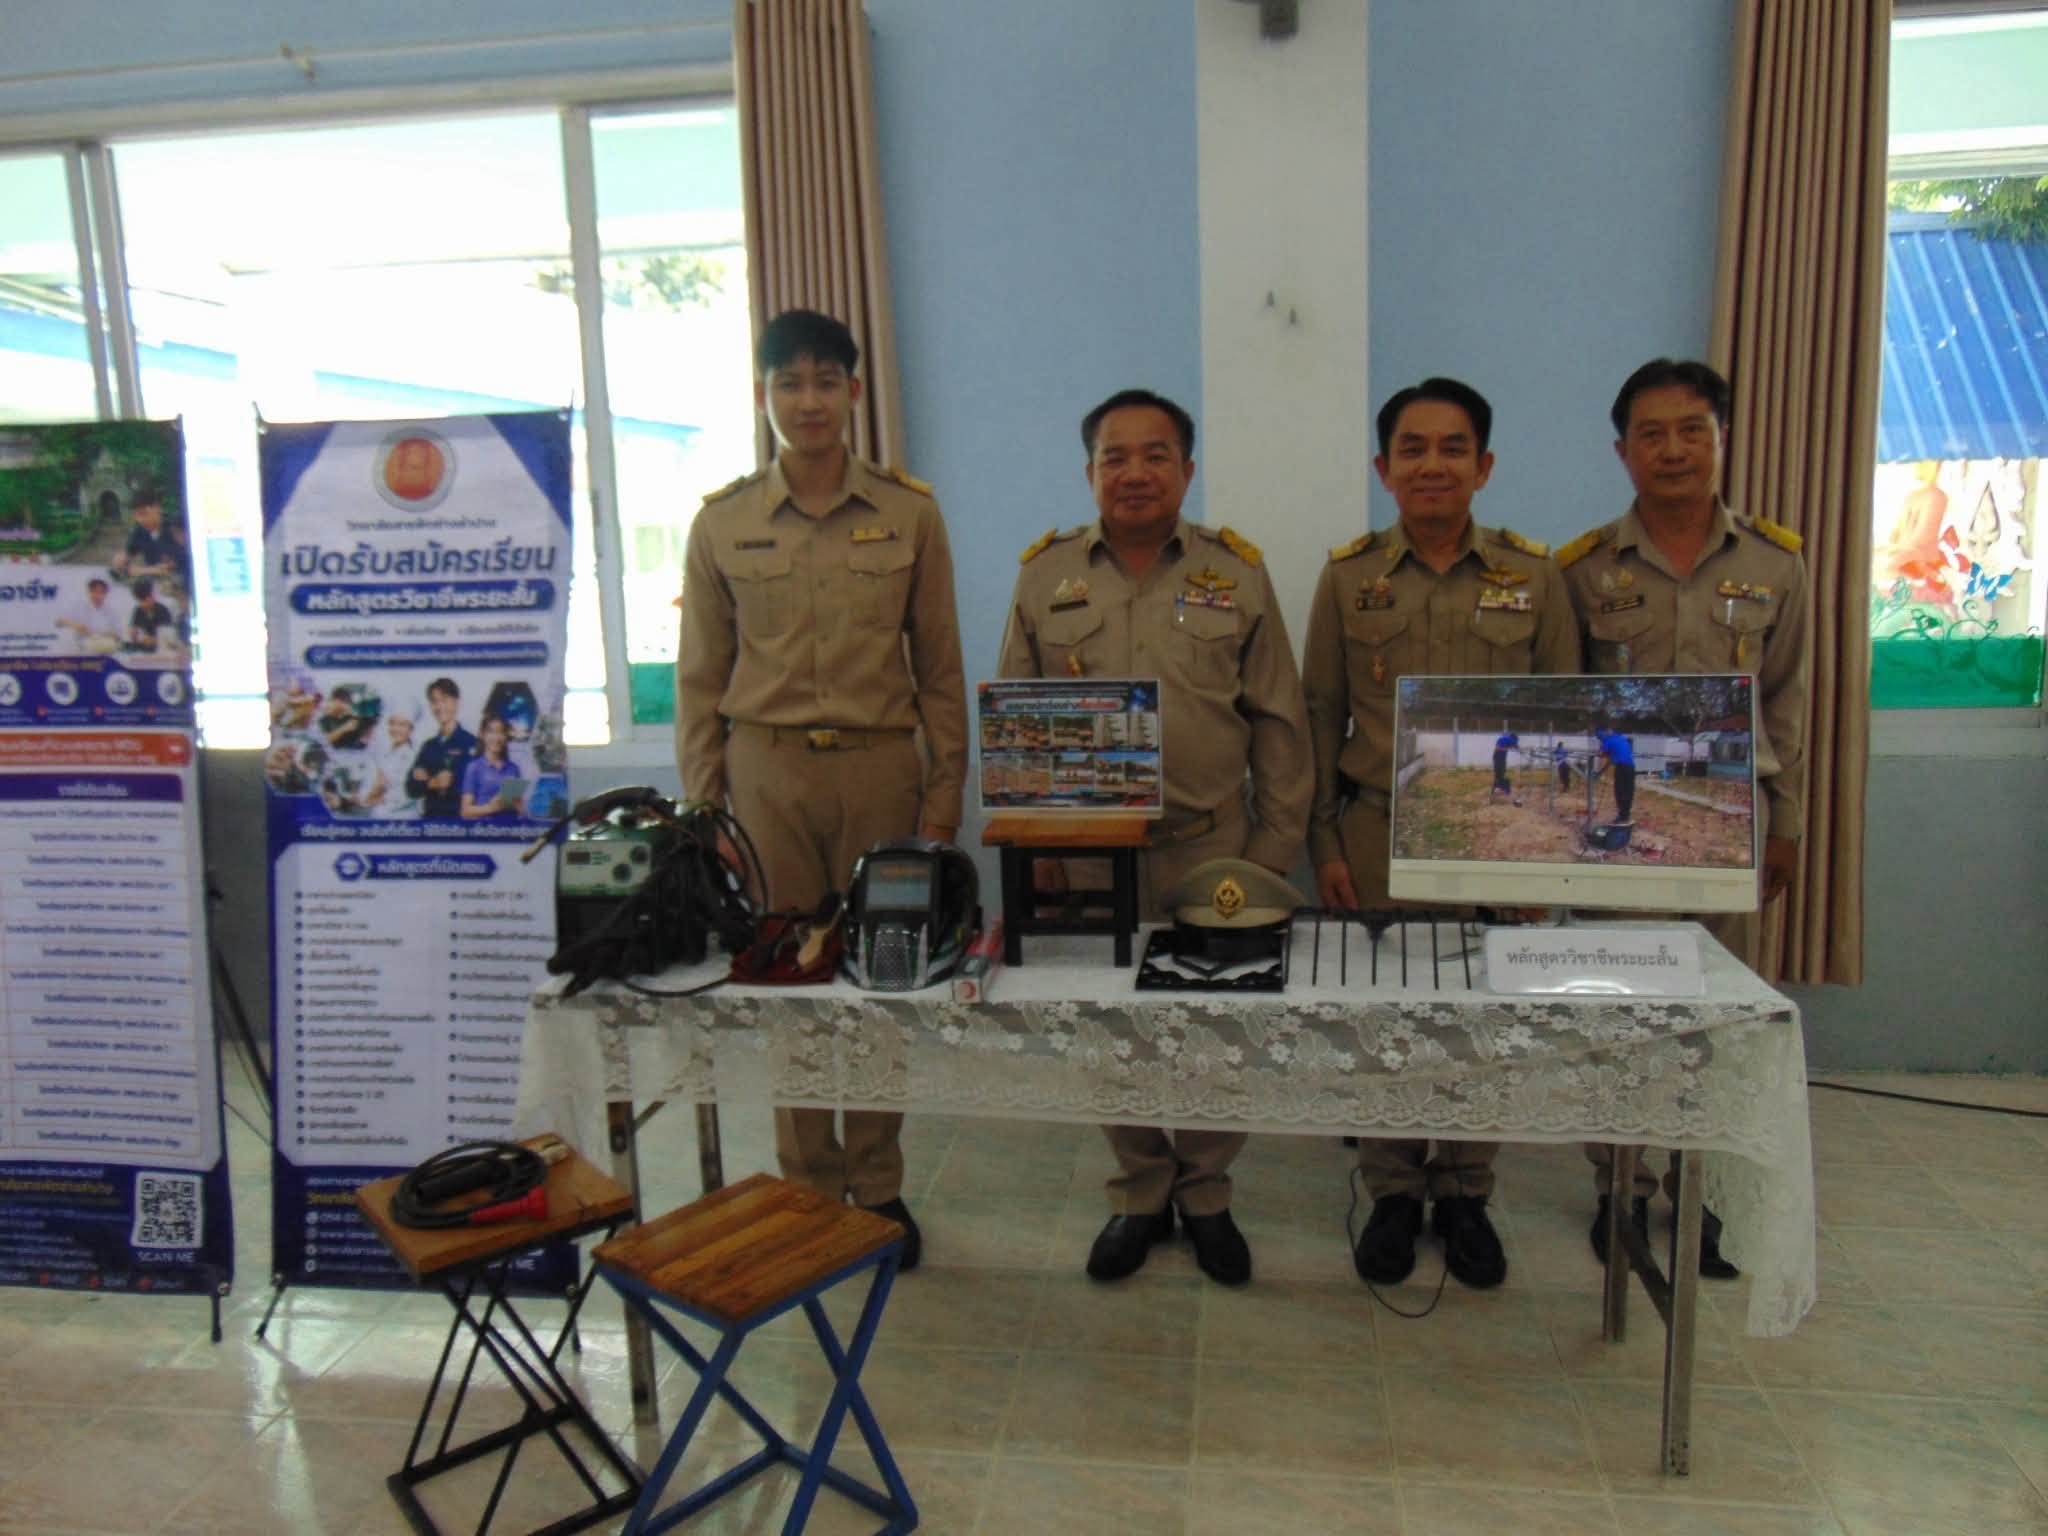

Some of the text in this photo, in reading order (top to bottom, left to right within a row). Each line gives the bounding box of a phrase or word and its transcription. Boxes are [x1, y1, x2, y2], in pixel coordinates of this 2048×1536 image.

[281, 536, 556, 577] เปิดรับสมัครเรียน
[307, 581, 538, 616] หลักสูตรวิชาชีพระยะสั้น
[1505, 944, 1679, 971] หลักสูตรวิชาชีพระยะสั้น
